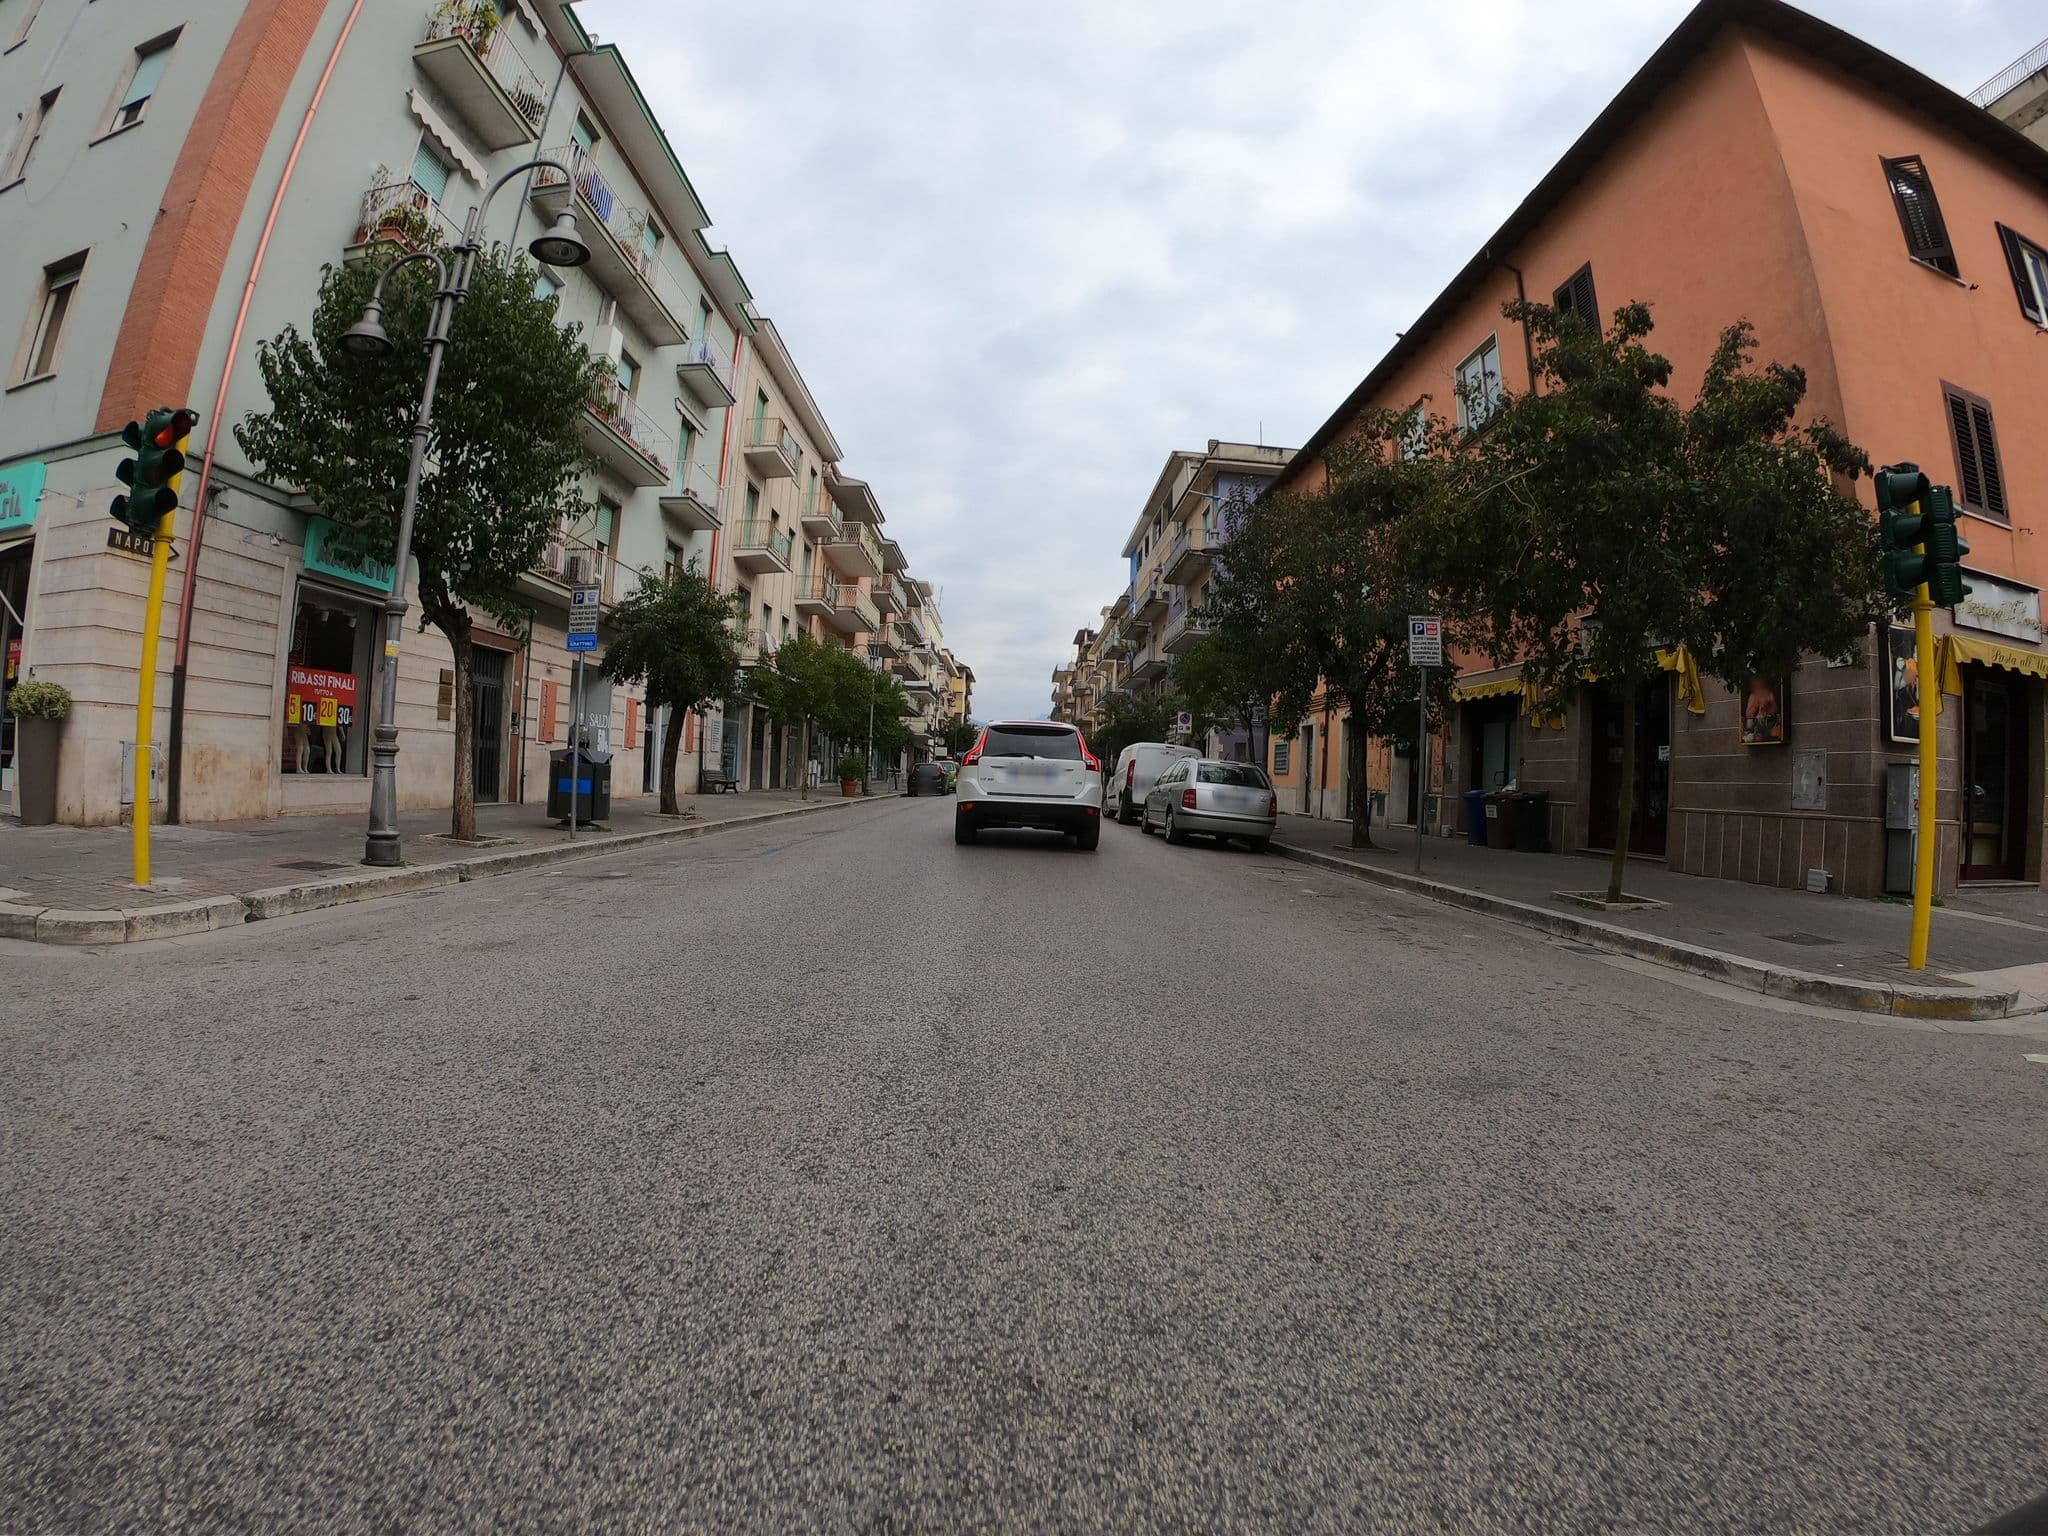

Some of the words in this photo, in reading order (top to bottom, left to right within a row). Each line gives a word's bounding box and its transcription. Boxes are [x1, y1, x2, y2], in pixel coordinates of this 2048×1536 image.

[291, 670, 327, 688] RIBASSI
[327, 675, 355, 691] FINALI
[314, 688, 329, 696] TUTTO
